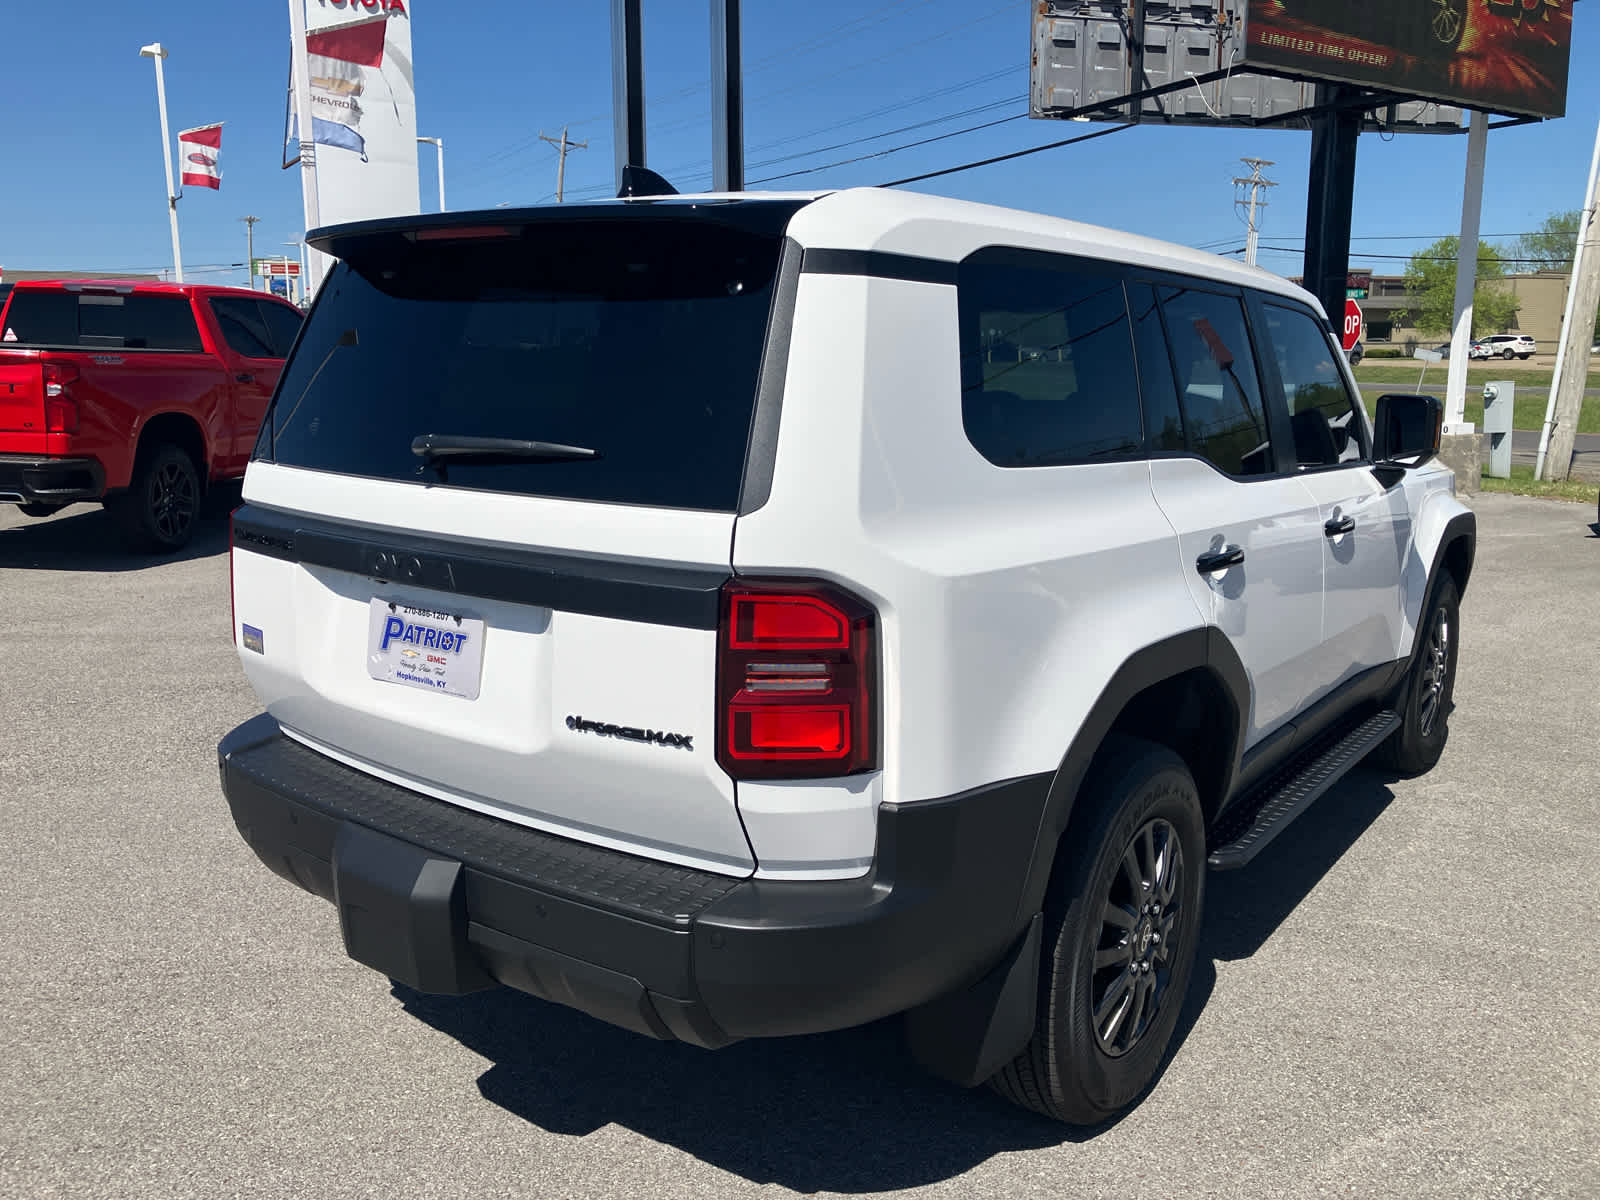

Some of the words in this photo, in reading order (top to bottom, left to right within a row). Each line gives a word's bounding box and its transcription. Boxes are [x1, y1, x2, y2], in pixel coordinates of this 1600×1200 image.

[1260, 31, 1314, 51] LIMITED
[1344, 315, 1360, 335] OP
[381, 615, 468, 653] PATRIOT
[426, 655, 447, 665] GMC
[396, 671, 436, 687] Hopkinsville,
[436, 680, 447, 688] KY
